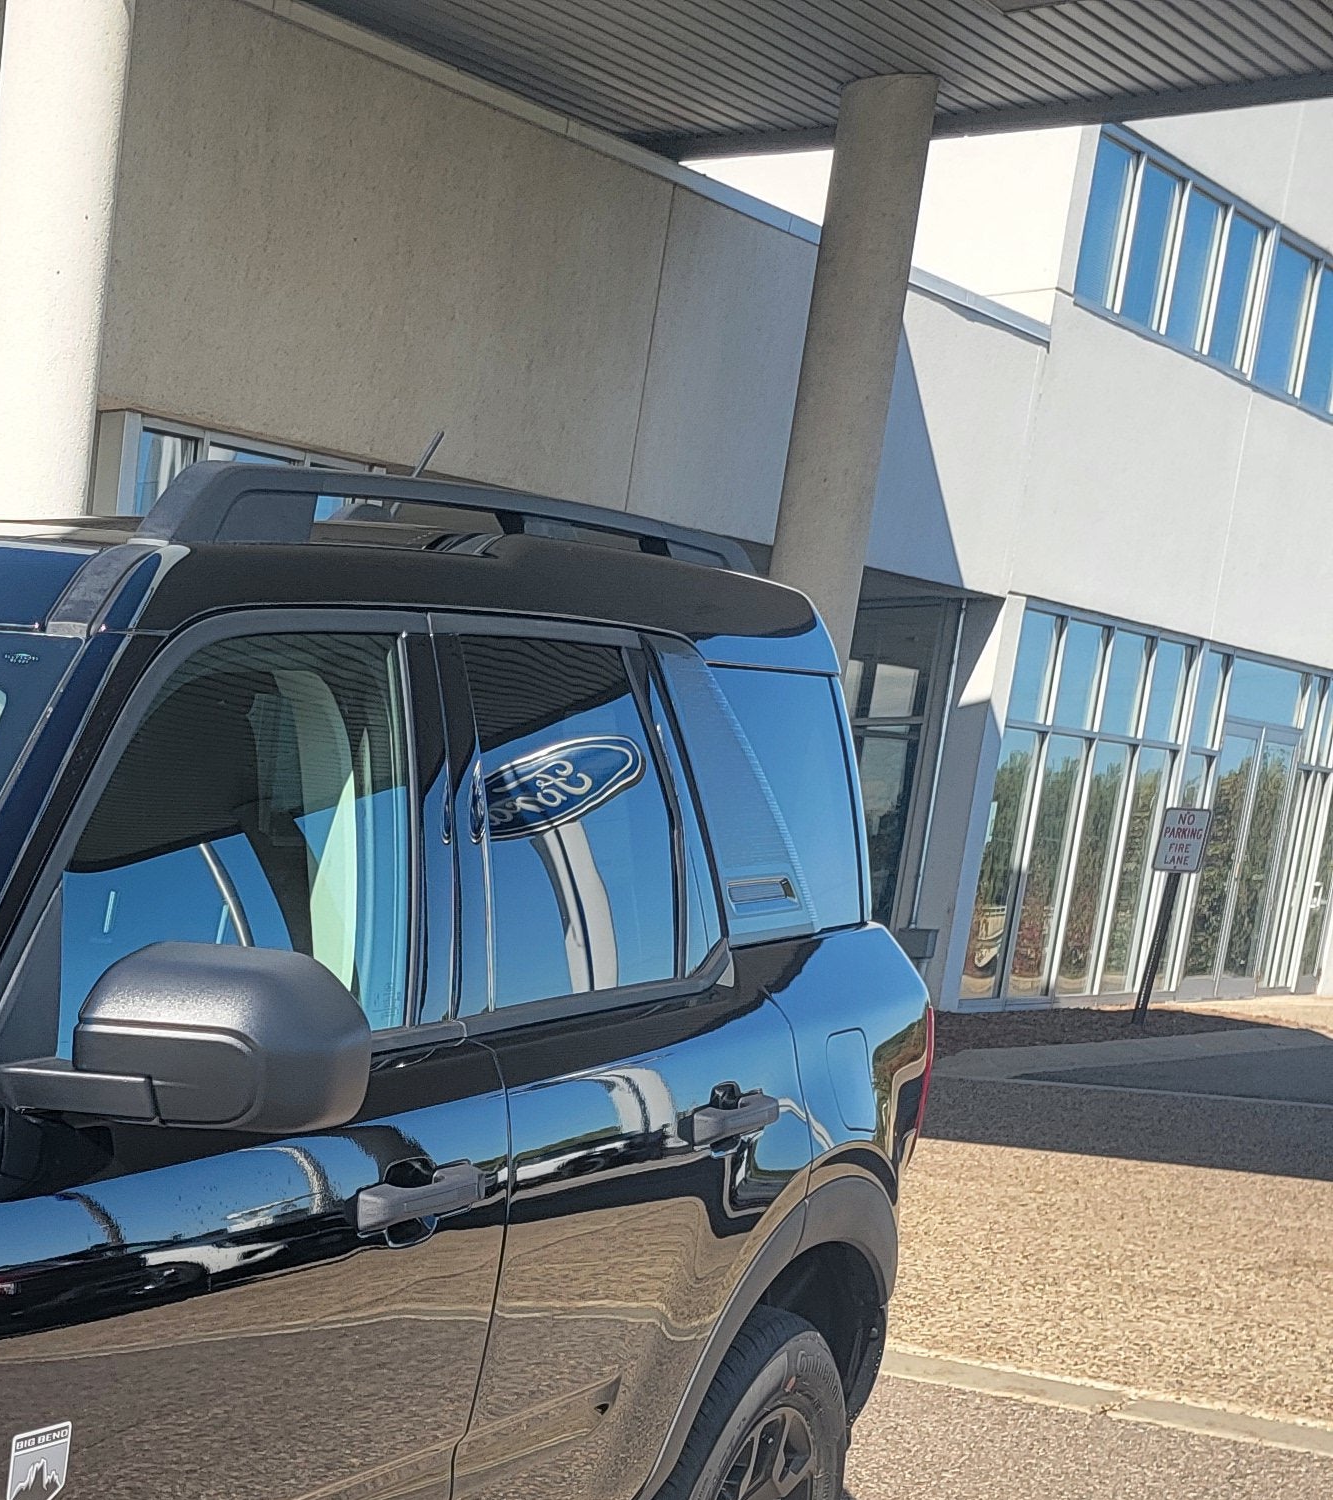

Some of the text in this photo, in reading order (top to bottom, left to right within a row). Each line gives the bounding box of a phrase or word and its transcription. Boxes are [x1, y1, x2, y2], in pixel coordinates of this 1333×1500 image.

[1178, 813, 1195, 826] NO
[1164, 826, 1203, 840] PARKING
[1168, 843, 1191, 854] FIRE
[1164, 855, 1190, 866] LANE
[16, 1428, 69, 1450] BIG BEND
